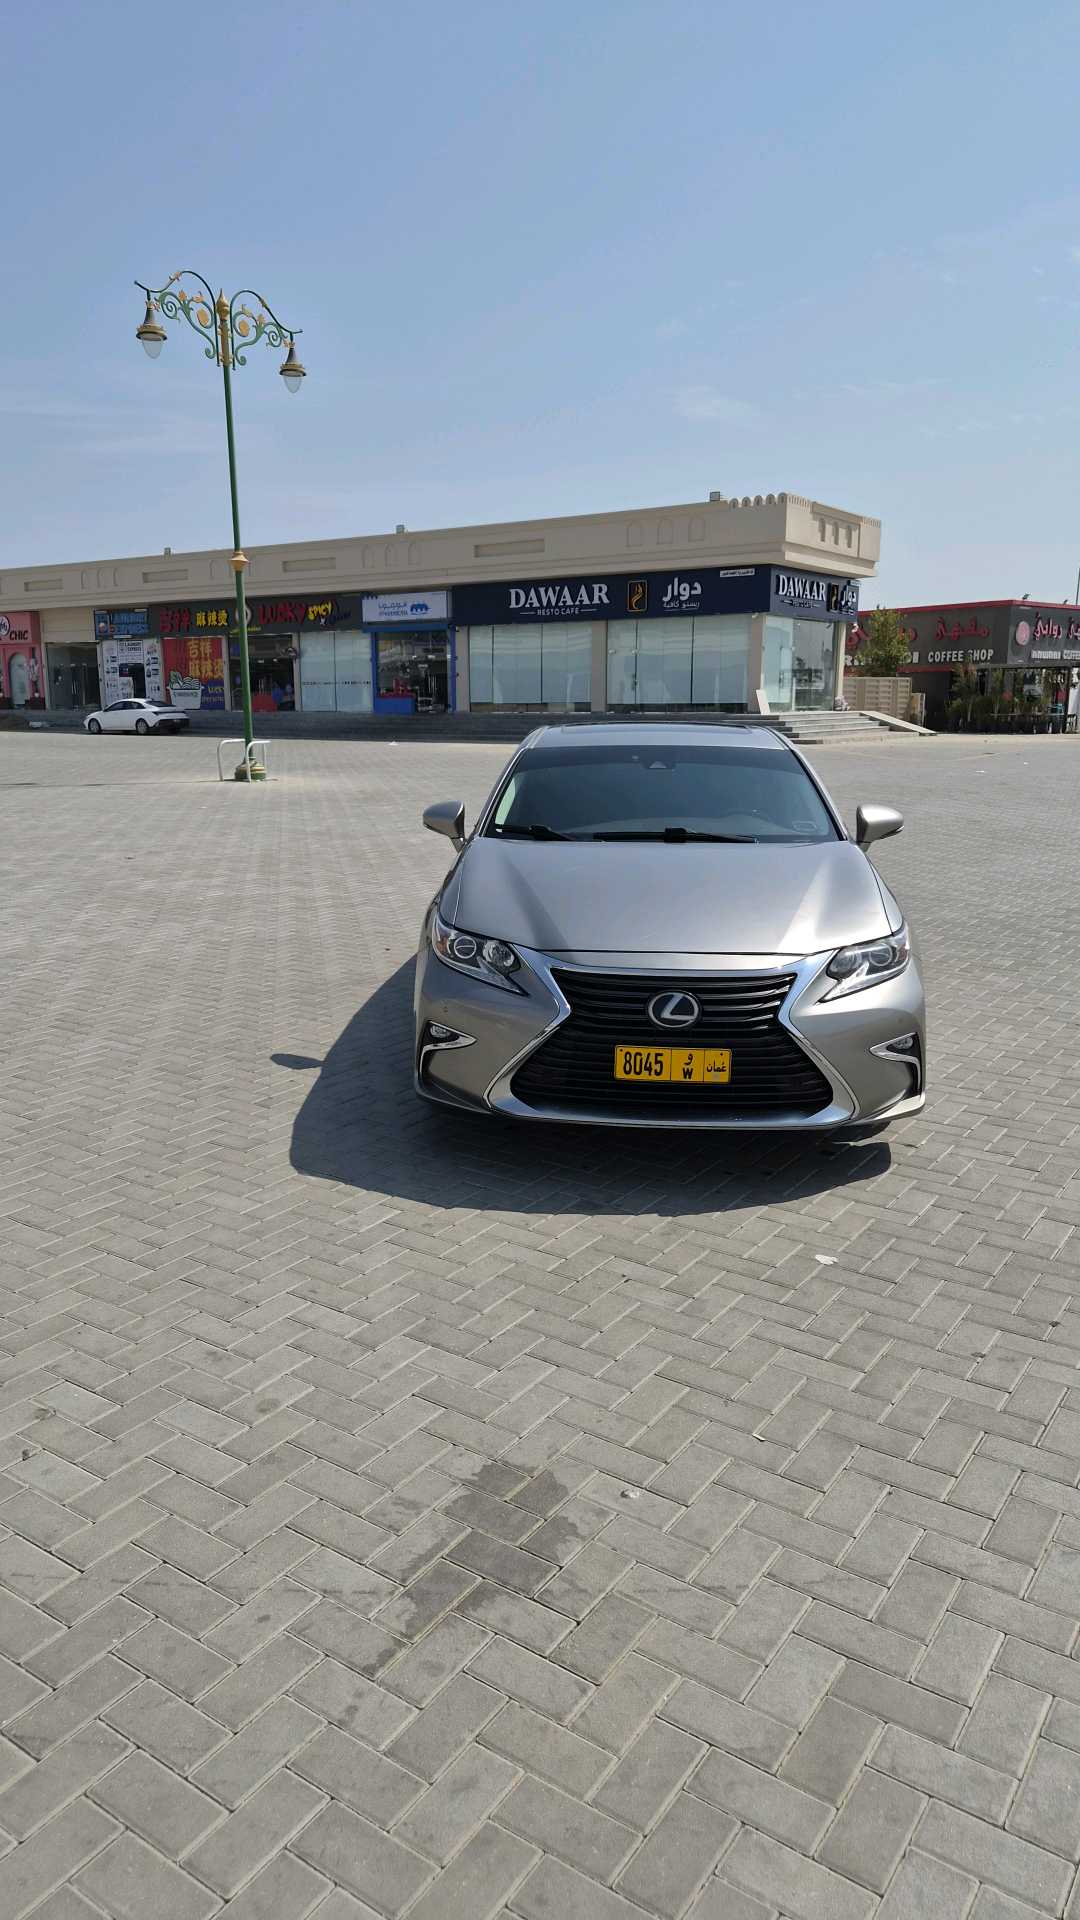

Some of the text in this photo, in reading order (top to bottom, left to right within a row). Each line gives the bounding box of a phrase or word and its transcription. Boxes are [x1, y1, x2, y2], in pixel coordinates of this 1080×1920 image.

[509, 584, 610, 608] DAWAAR
[662, 577, 702, 601] دوار
[779, 575, 826, 601] DAWAAR
[258, 601, 305, 625] LUCKY
[309, 602, 332, 620] SPICY
[537, 607, 580, 616] RESTO CAFE
[10, 630, 28, 640] CHIC
[928, 651, 963, 662] COFFEE
[623, 1051, 664, 1077] 8045
[684, 1053, 694, 1066] و
[682, 1067, 694, 1079] W
